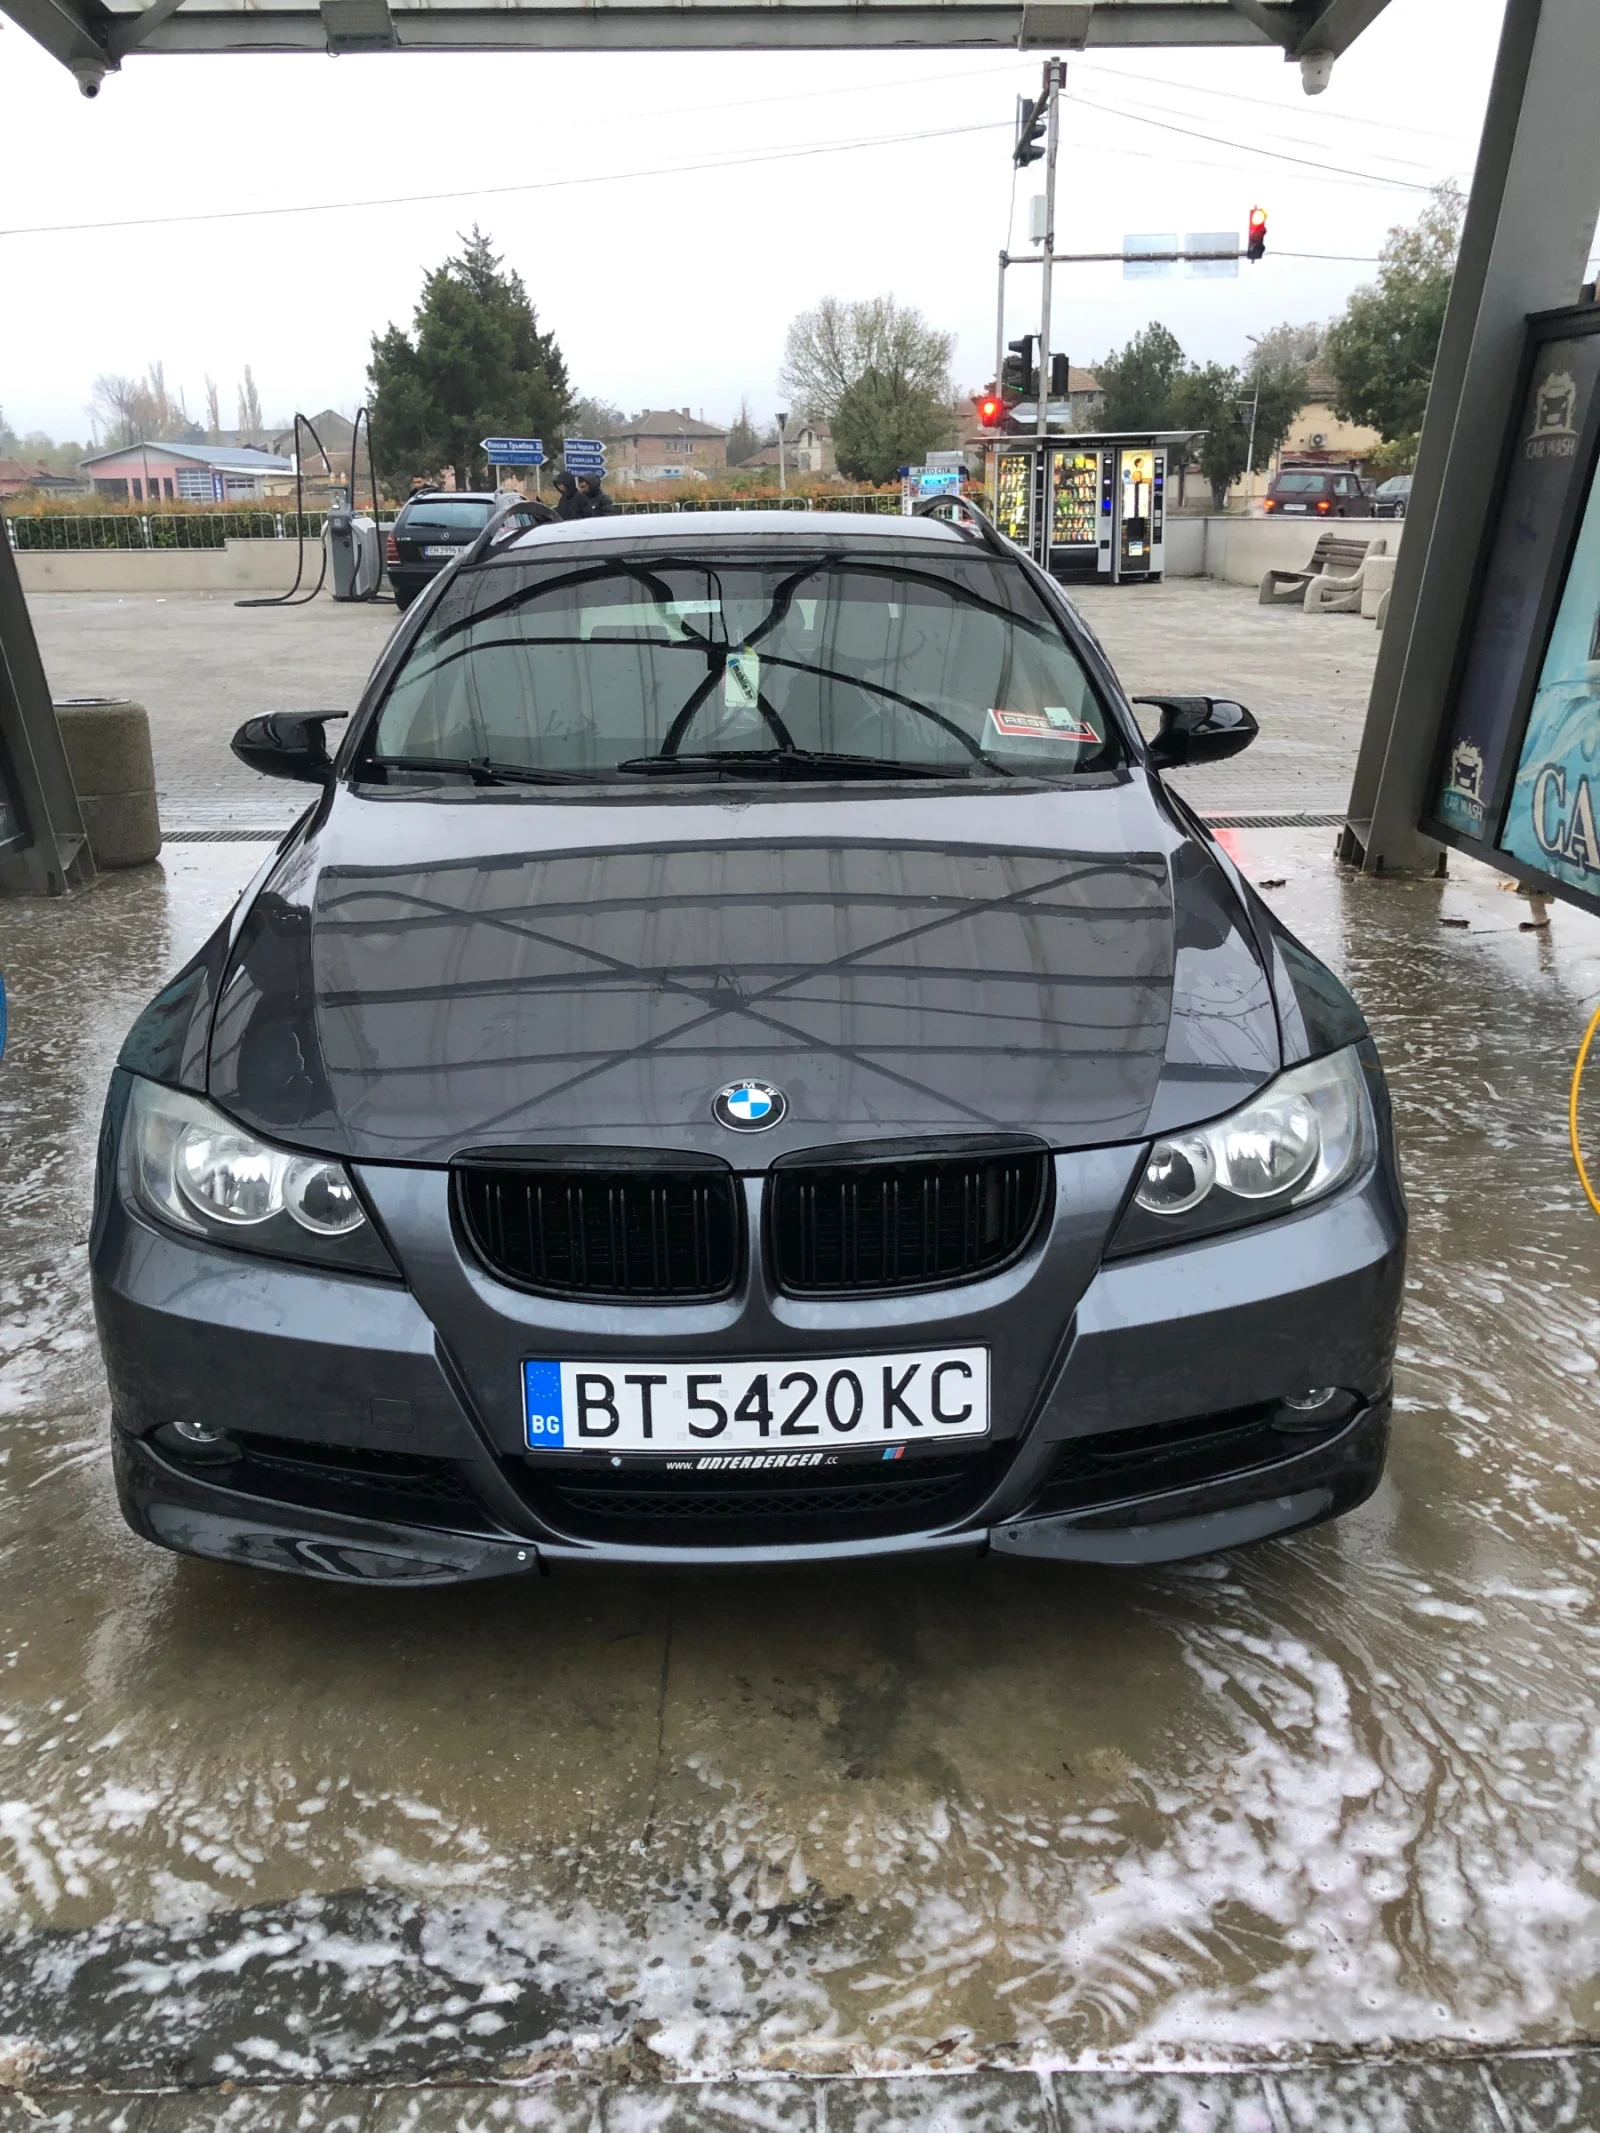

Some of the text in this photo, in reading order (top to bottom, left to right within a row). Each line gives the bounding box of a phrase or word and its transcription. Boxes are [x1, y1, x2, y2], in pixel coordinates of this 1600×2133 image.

[722, 1083, 778, 1096] BMW
[574, 1360, 974, 1439] BT 5420 KC
[531, 1415, 561, 1434] BG
